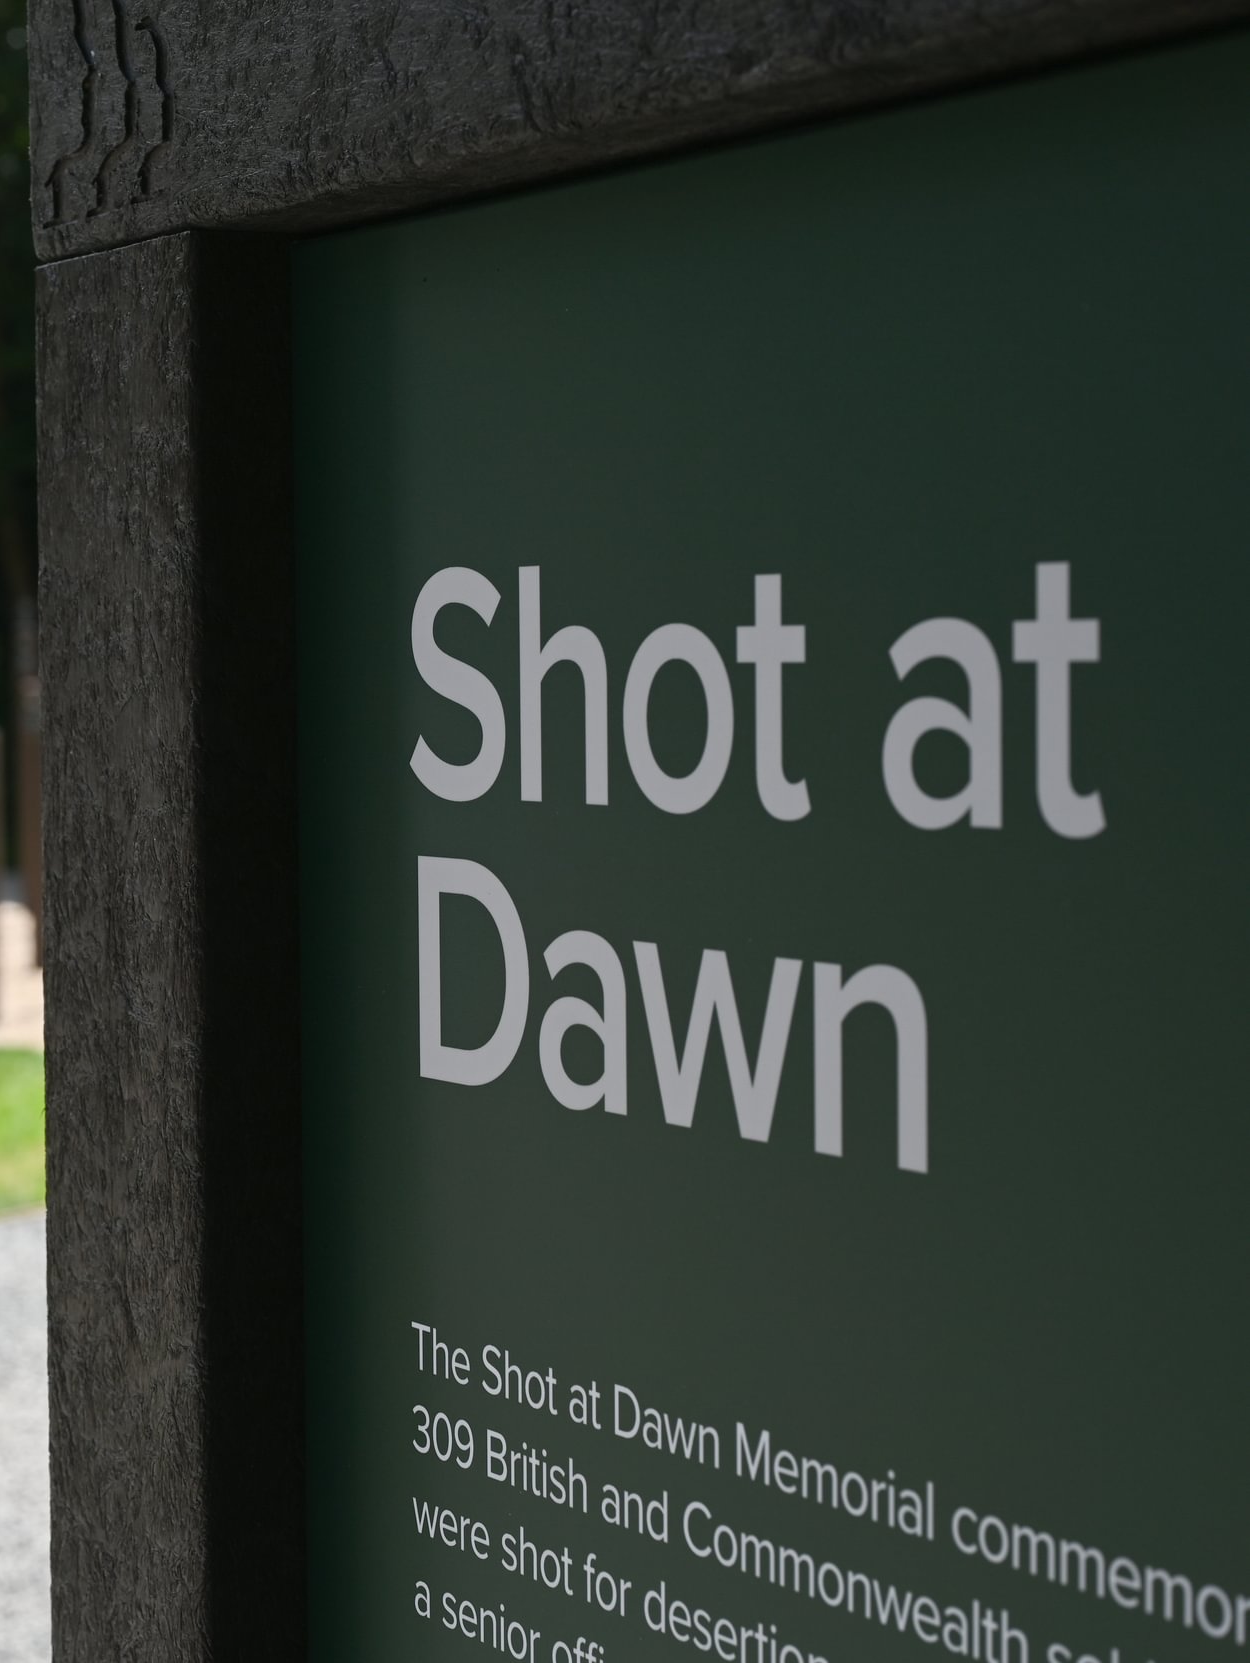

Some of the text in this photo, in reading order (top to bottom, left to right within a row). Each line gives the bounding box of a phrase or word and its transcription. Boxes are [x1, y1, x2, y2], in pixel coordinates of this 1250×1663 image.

[409, 561, 1107, 839] Shot at
[417, 855, 929, 1174] Dawn
[411, 1320, 471, 1386] The
[481, 1344, 559, 1416] Shot
[568, 1380, 602, 1431] at
[613, 1383, 721, 1470] Dawn
[735, 1421, 936, 1541] Memorial
[412, 1404, 1030, 1663] 309 British and Commonwealth
[412, 1496, 491, 1560] were
[501, 1525, 574, 1597] shot
[582, 1552, 634, 1617] for
[414, 1580, 431, 1619] a
[441, 1591, 541, 1663] senior
